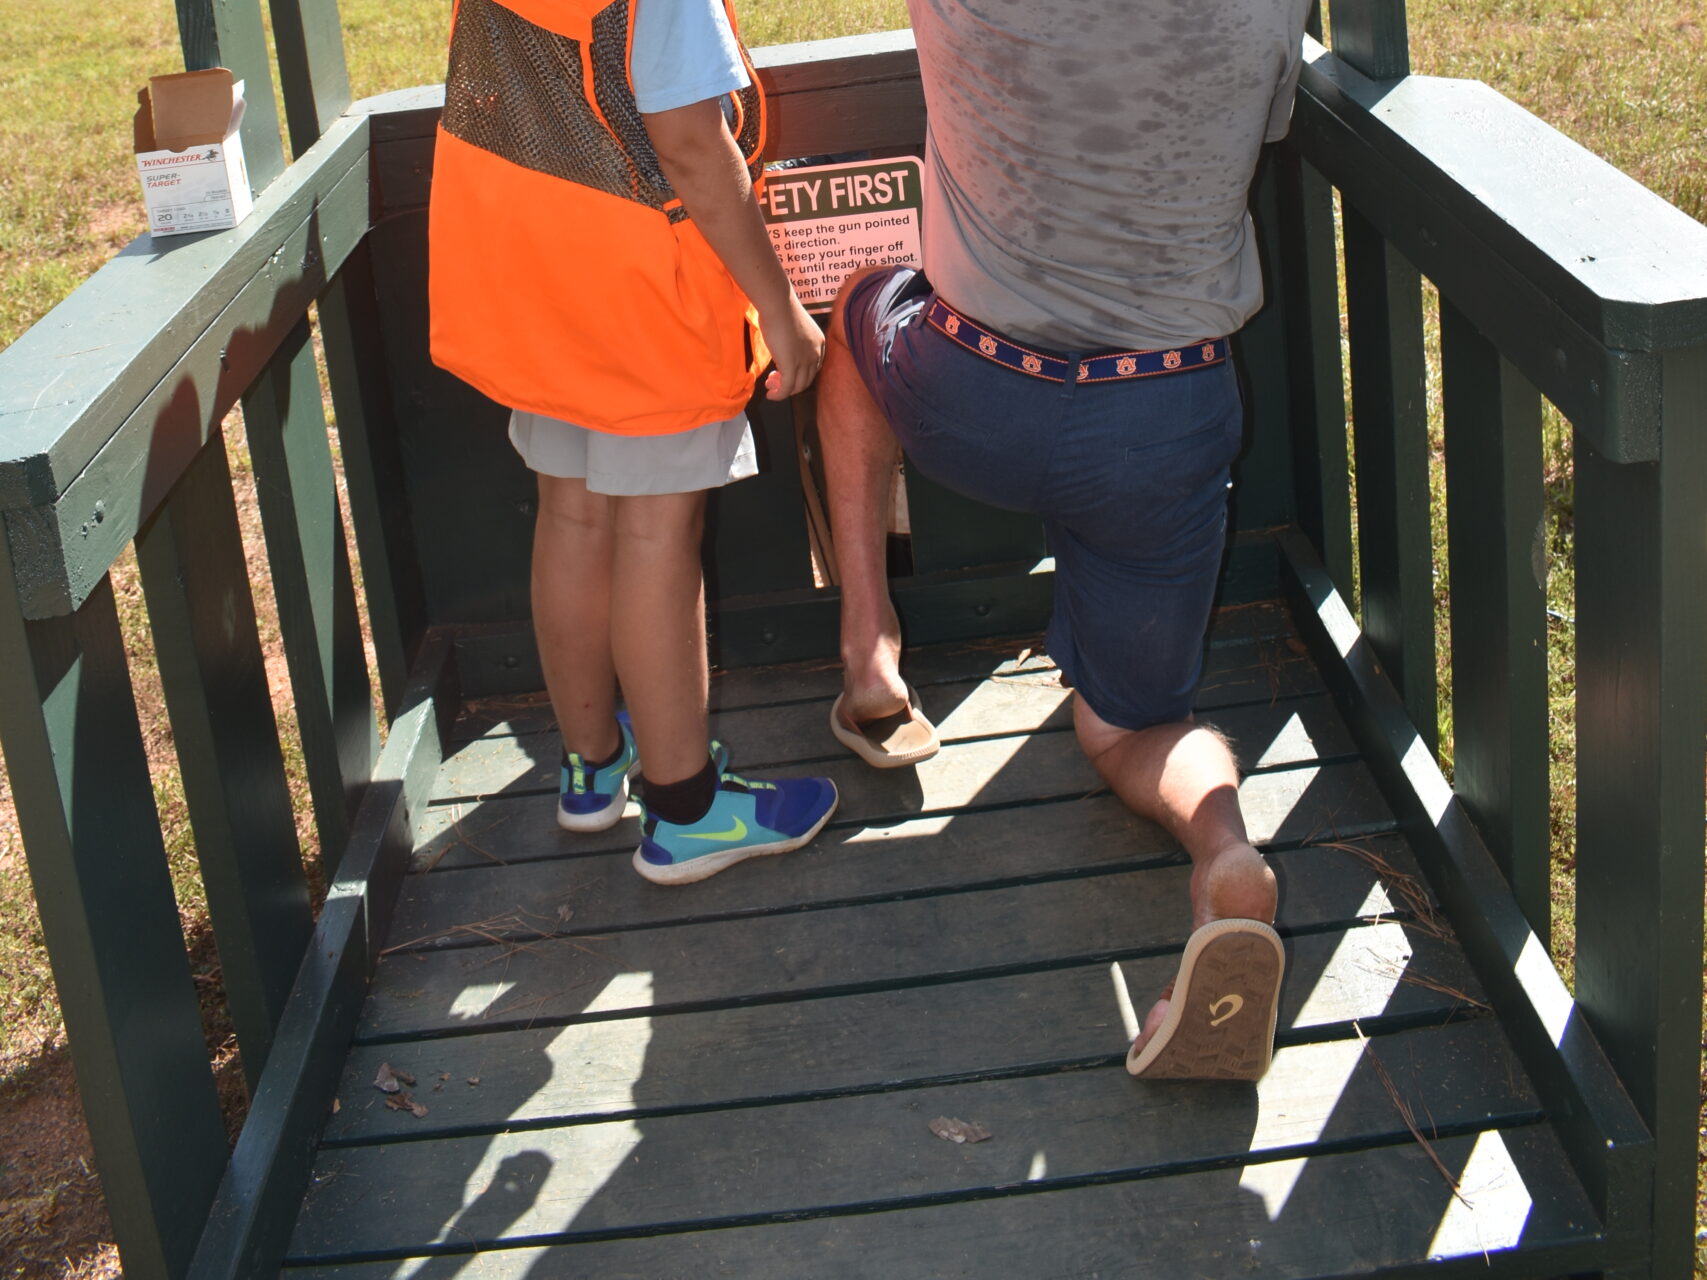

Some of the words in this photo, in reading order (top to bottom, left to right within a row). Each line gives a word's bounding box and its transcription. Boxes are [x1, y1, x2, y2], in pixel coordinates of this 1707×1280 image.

[142, 153, 203, 167] WINCHESTER
[147, 178, 182, 188] TARGET
[829, 170, 909, 210] FIRST
[157, 213, 173, 222] 20
[784, 227, 813, 238] keep
[816, 224, 835, 234] the
[838, 221, 861, 234] gun
[865, 215, 910, 231] pointed
[784, 237, 840, 250] direction.
[787, 252, 816, 263] keep
[819, 249, 846, 262] your
[849, 244, 885, 257] finger
[887, 240, 904, 252] off
[799, 262, 825, 274] until
[828, 259, 861, 270] ready
[865, 257, 877, 267] to
[880, 253, 918, 265] shoot.
[822, 273, 840, 284] the
